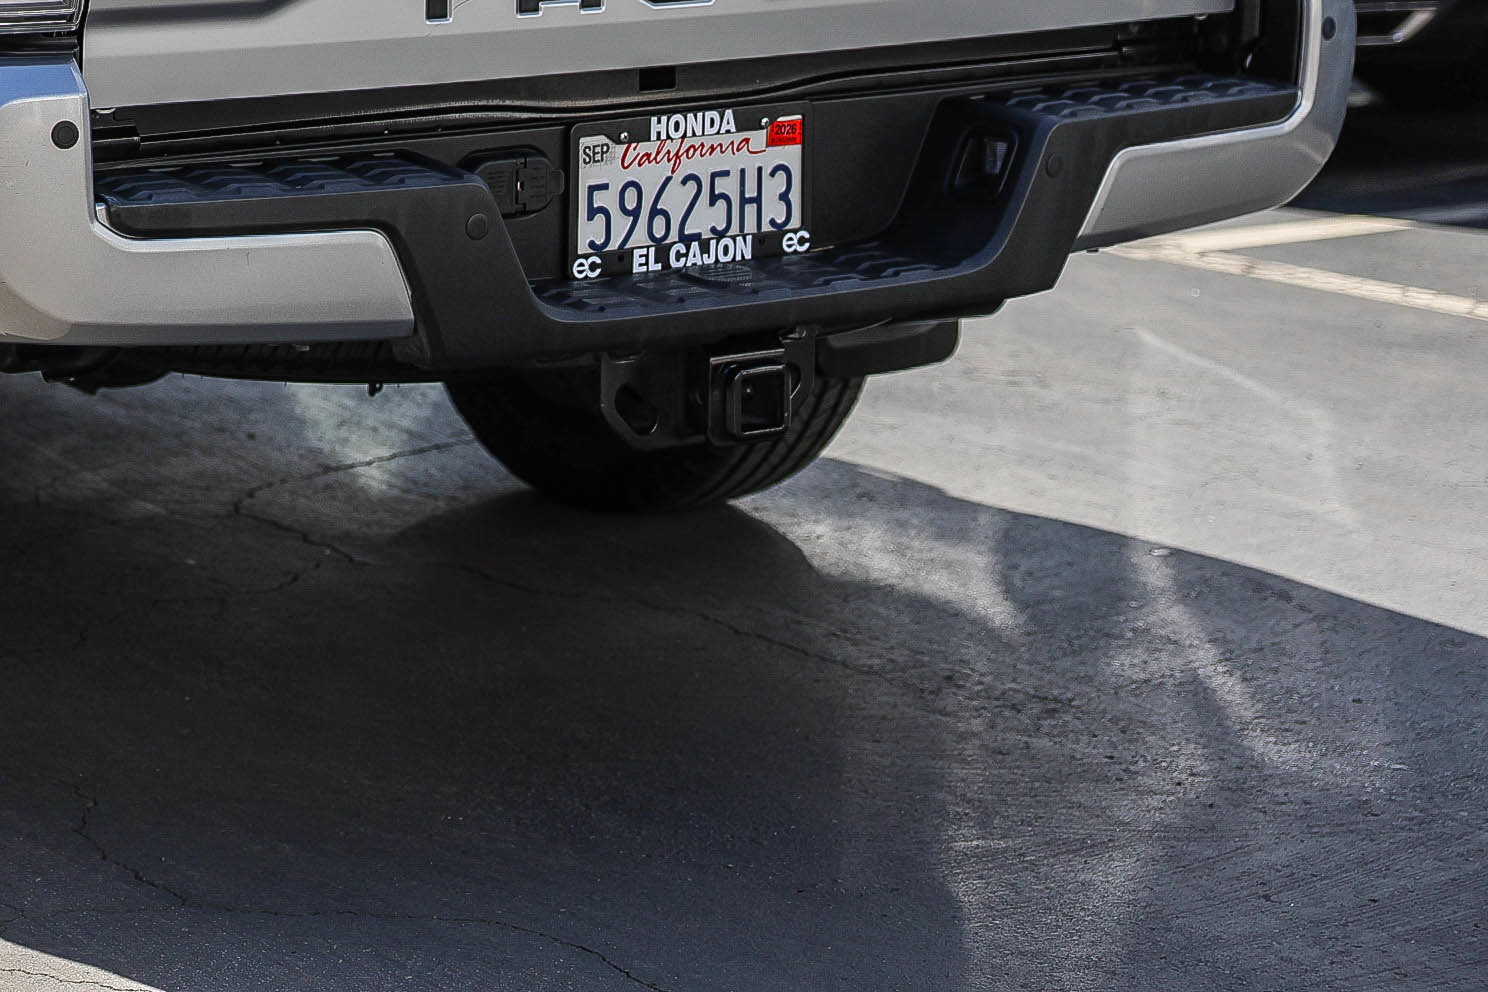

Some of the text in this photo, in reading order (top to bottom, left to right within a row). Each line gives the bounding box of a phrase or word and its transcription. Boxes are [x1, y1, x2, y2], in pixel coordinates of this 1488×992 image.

[650, 109, 736, 141] HONDA
[775, 123, 798, 135] 2026
[582, 143, 611, 166] SEP
[620, 136, 766, 175] California
[586, 164, 794, 252] 59625H3
[632, 234, 753, 274] EL CAJON
